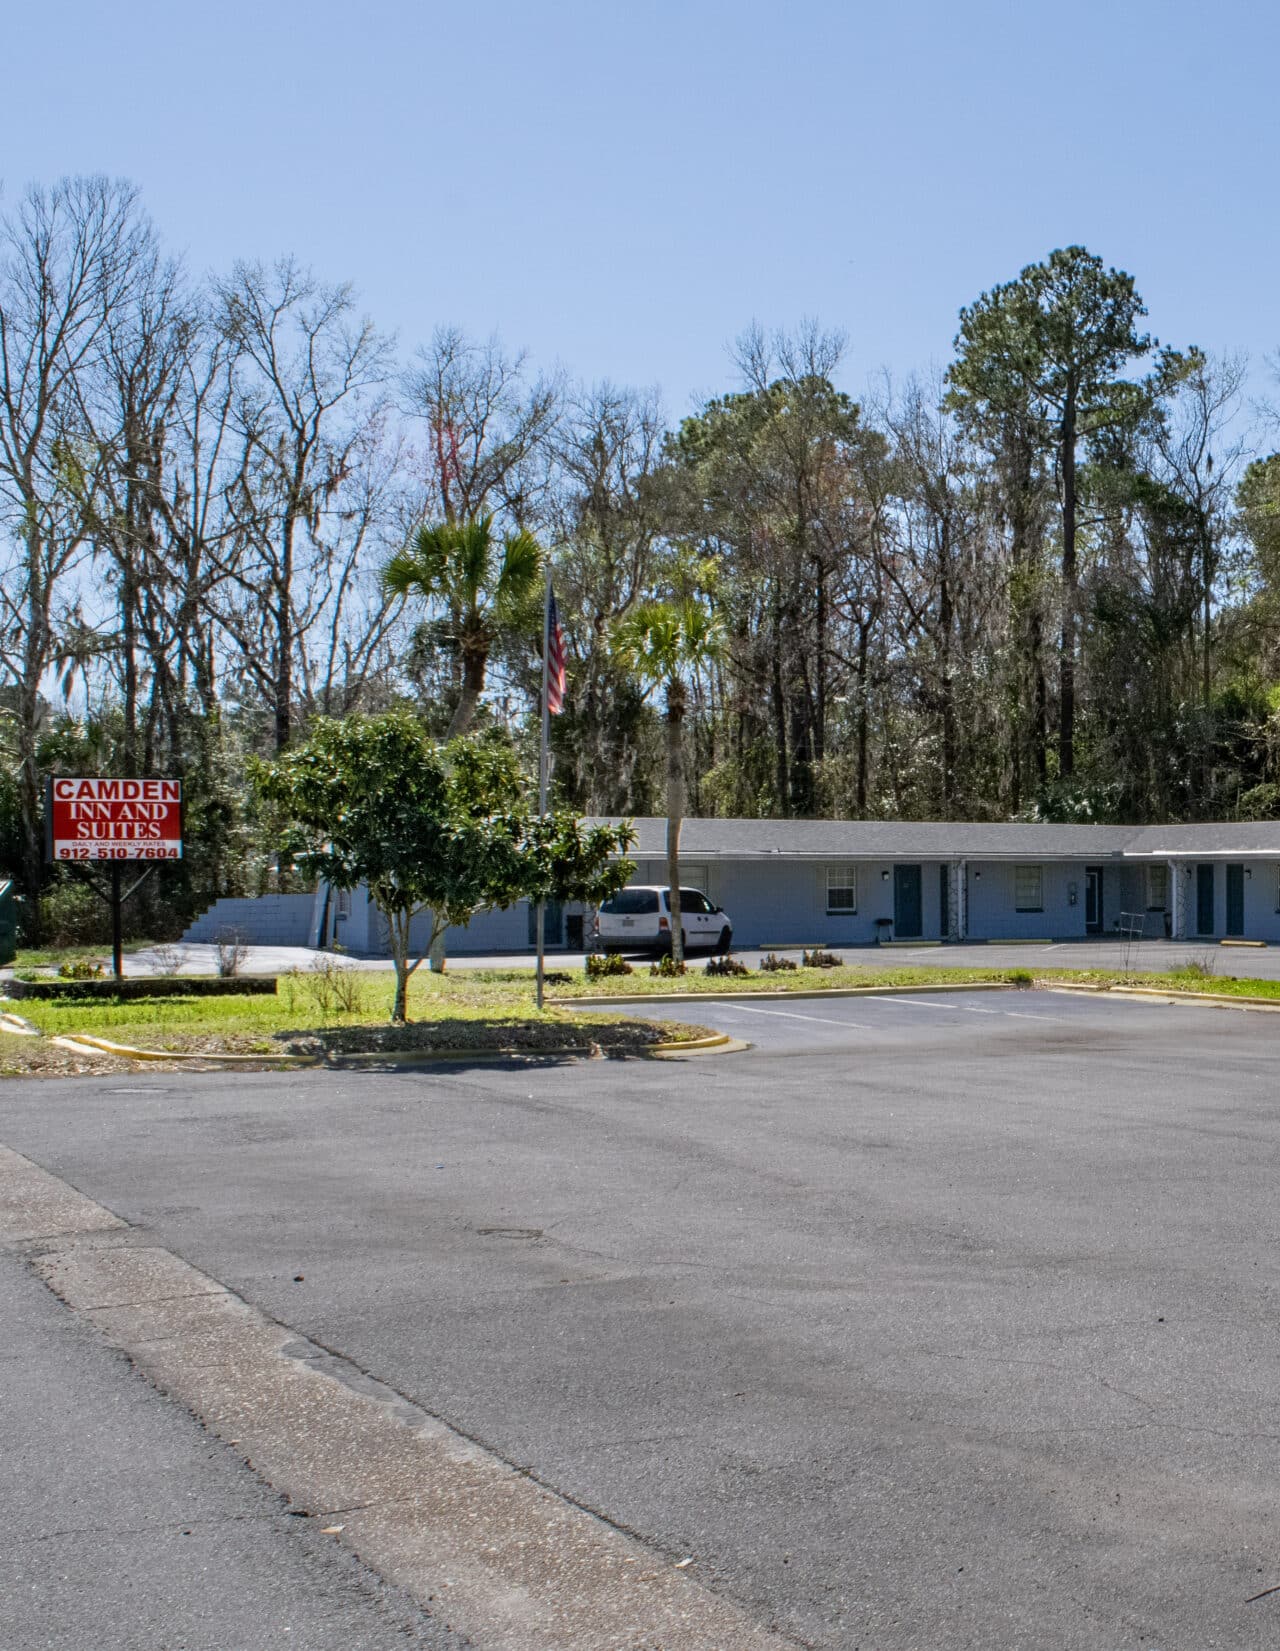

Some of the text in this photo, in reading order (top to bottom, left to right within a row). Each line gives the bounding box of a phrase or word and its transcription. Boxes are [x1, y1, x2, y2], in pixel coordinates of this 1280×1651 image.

[55, 780, 179, 800] CAMDEN
[69, 802, 168, 820] INN AND
[77, 822, 161, 839] SUITES
[60, 847, 178, 859] 912-510-7604
